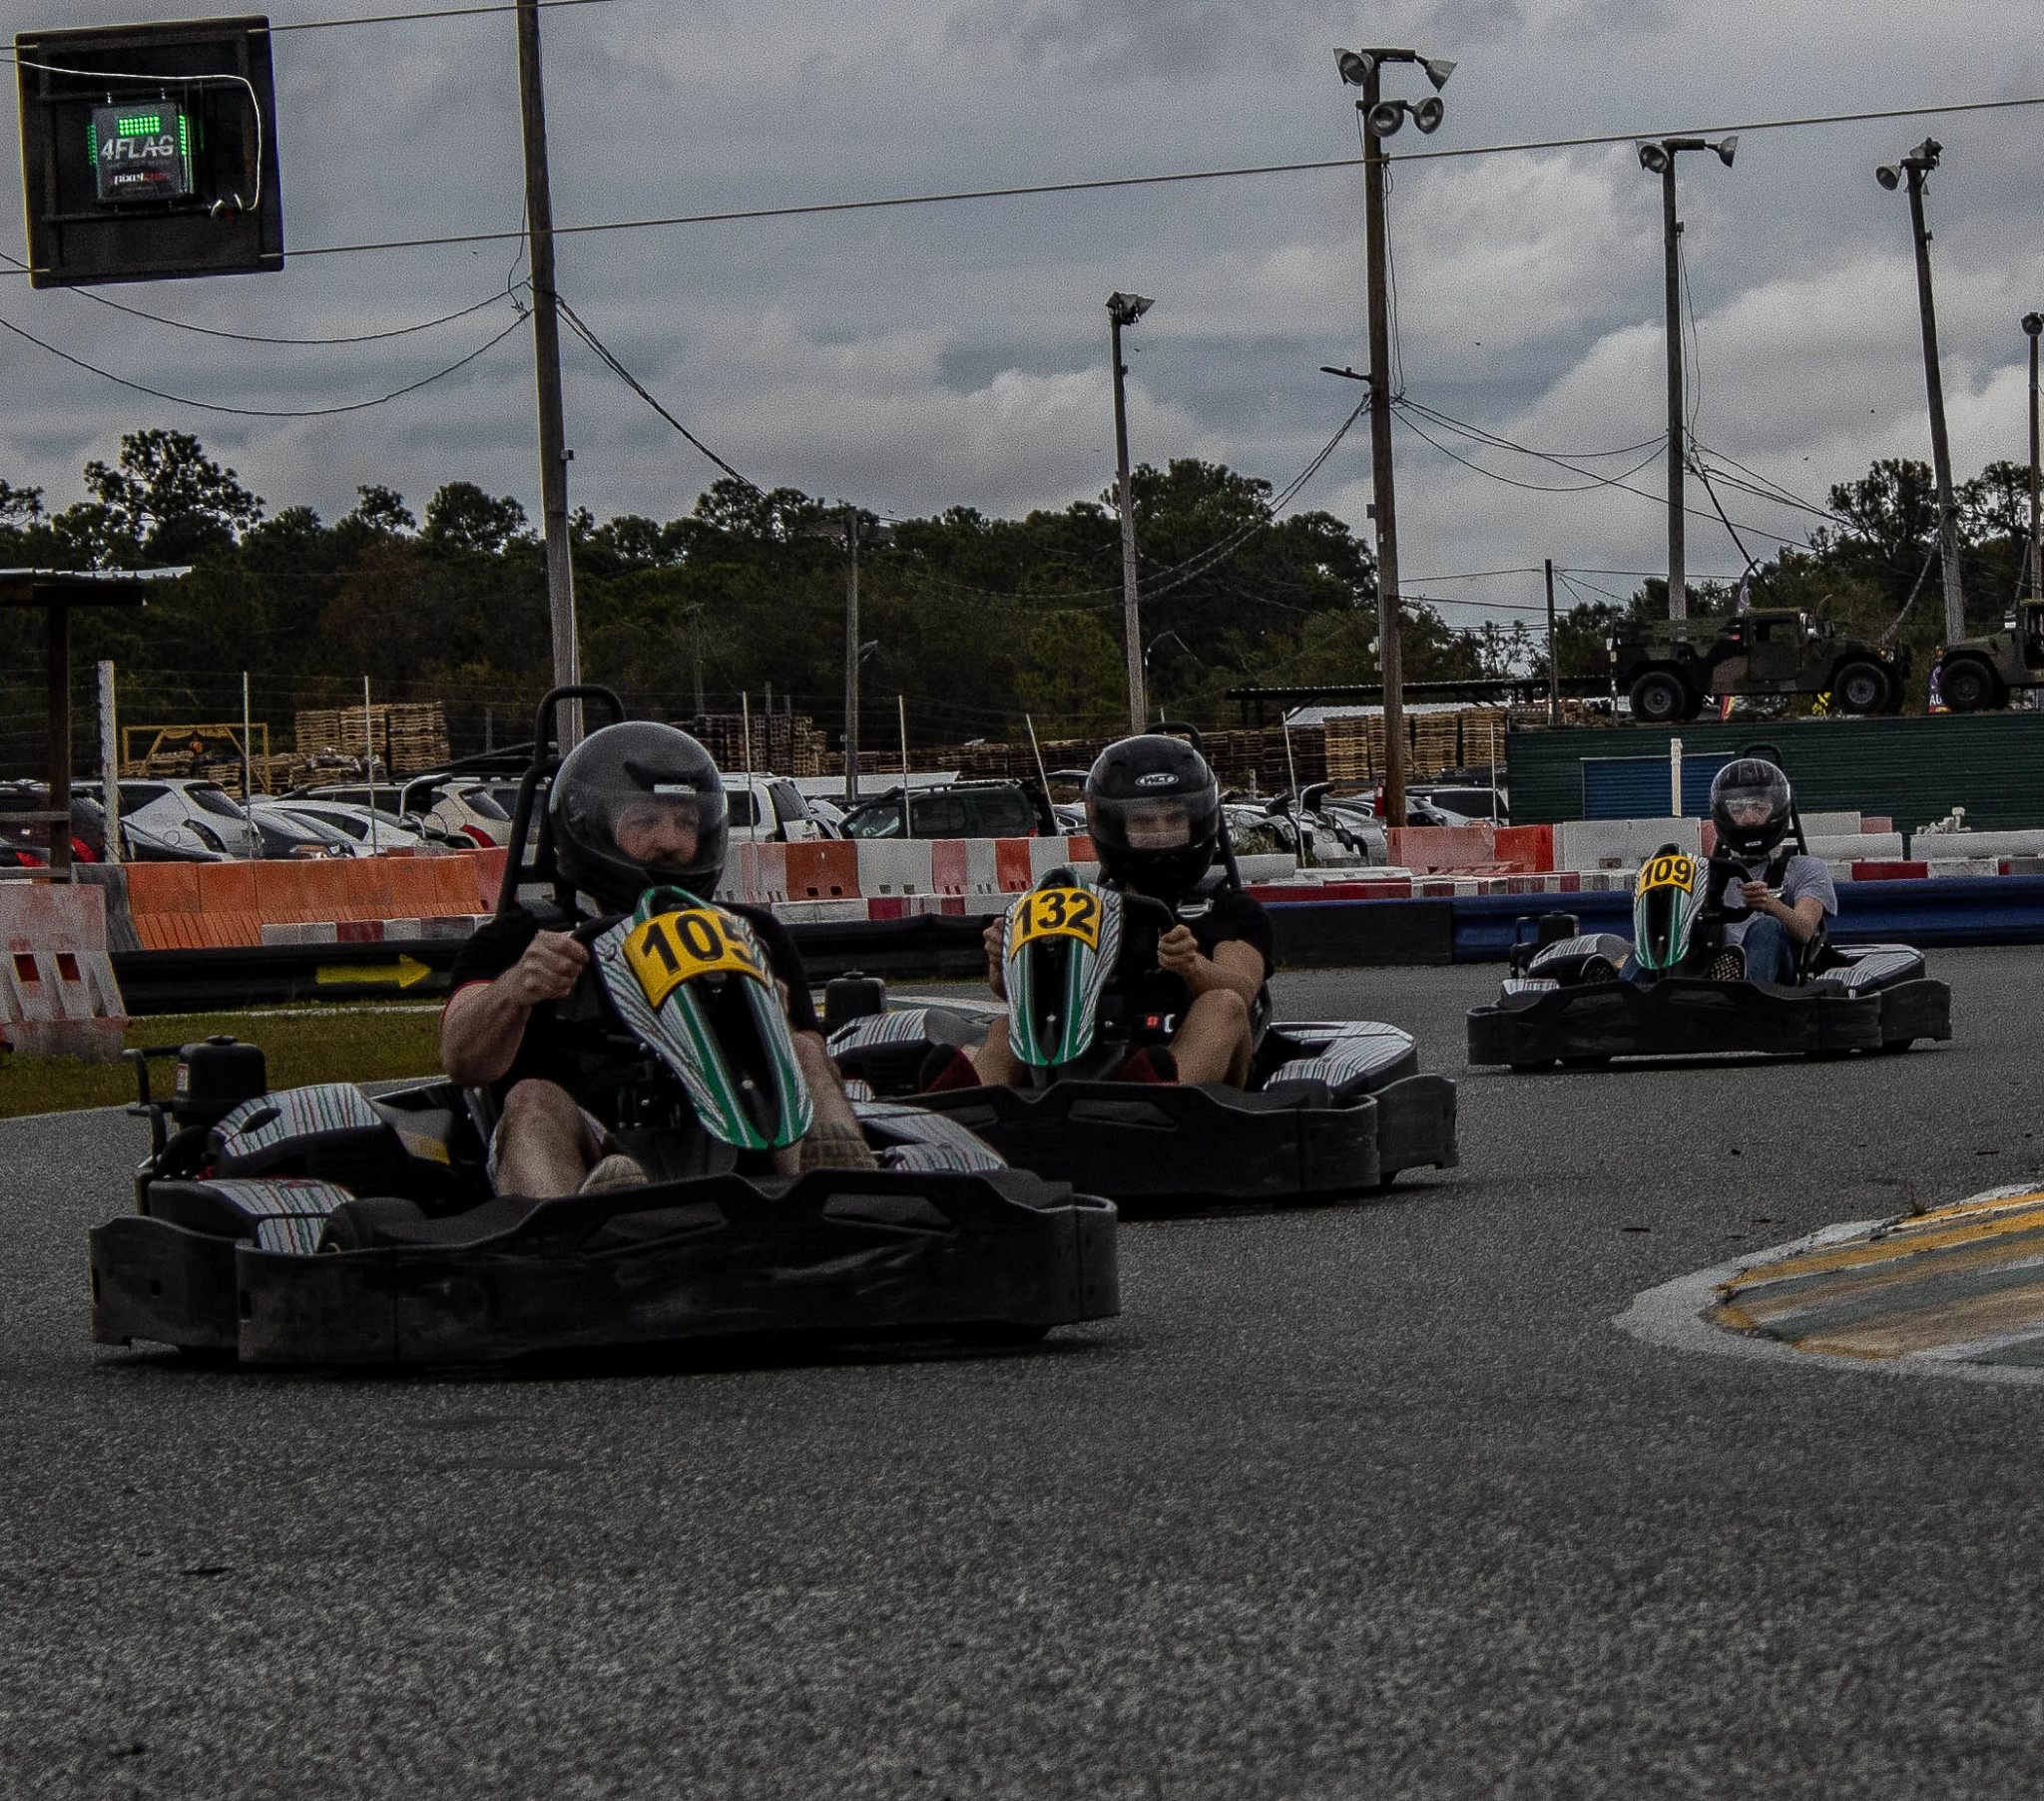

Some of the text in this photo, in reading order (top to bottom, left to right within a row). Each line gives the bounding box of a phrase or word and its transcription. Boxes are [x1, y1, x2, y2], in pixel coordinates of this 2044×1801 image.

[101, 135, 174, 160] 4FLAG
[1642, 859, 1691, 887] 109
[1016, 892, 1095, 938] 132
[641, 913, 763, 976] 105
